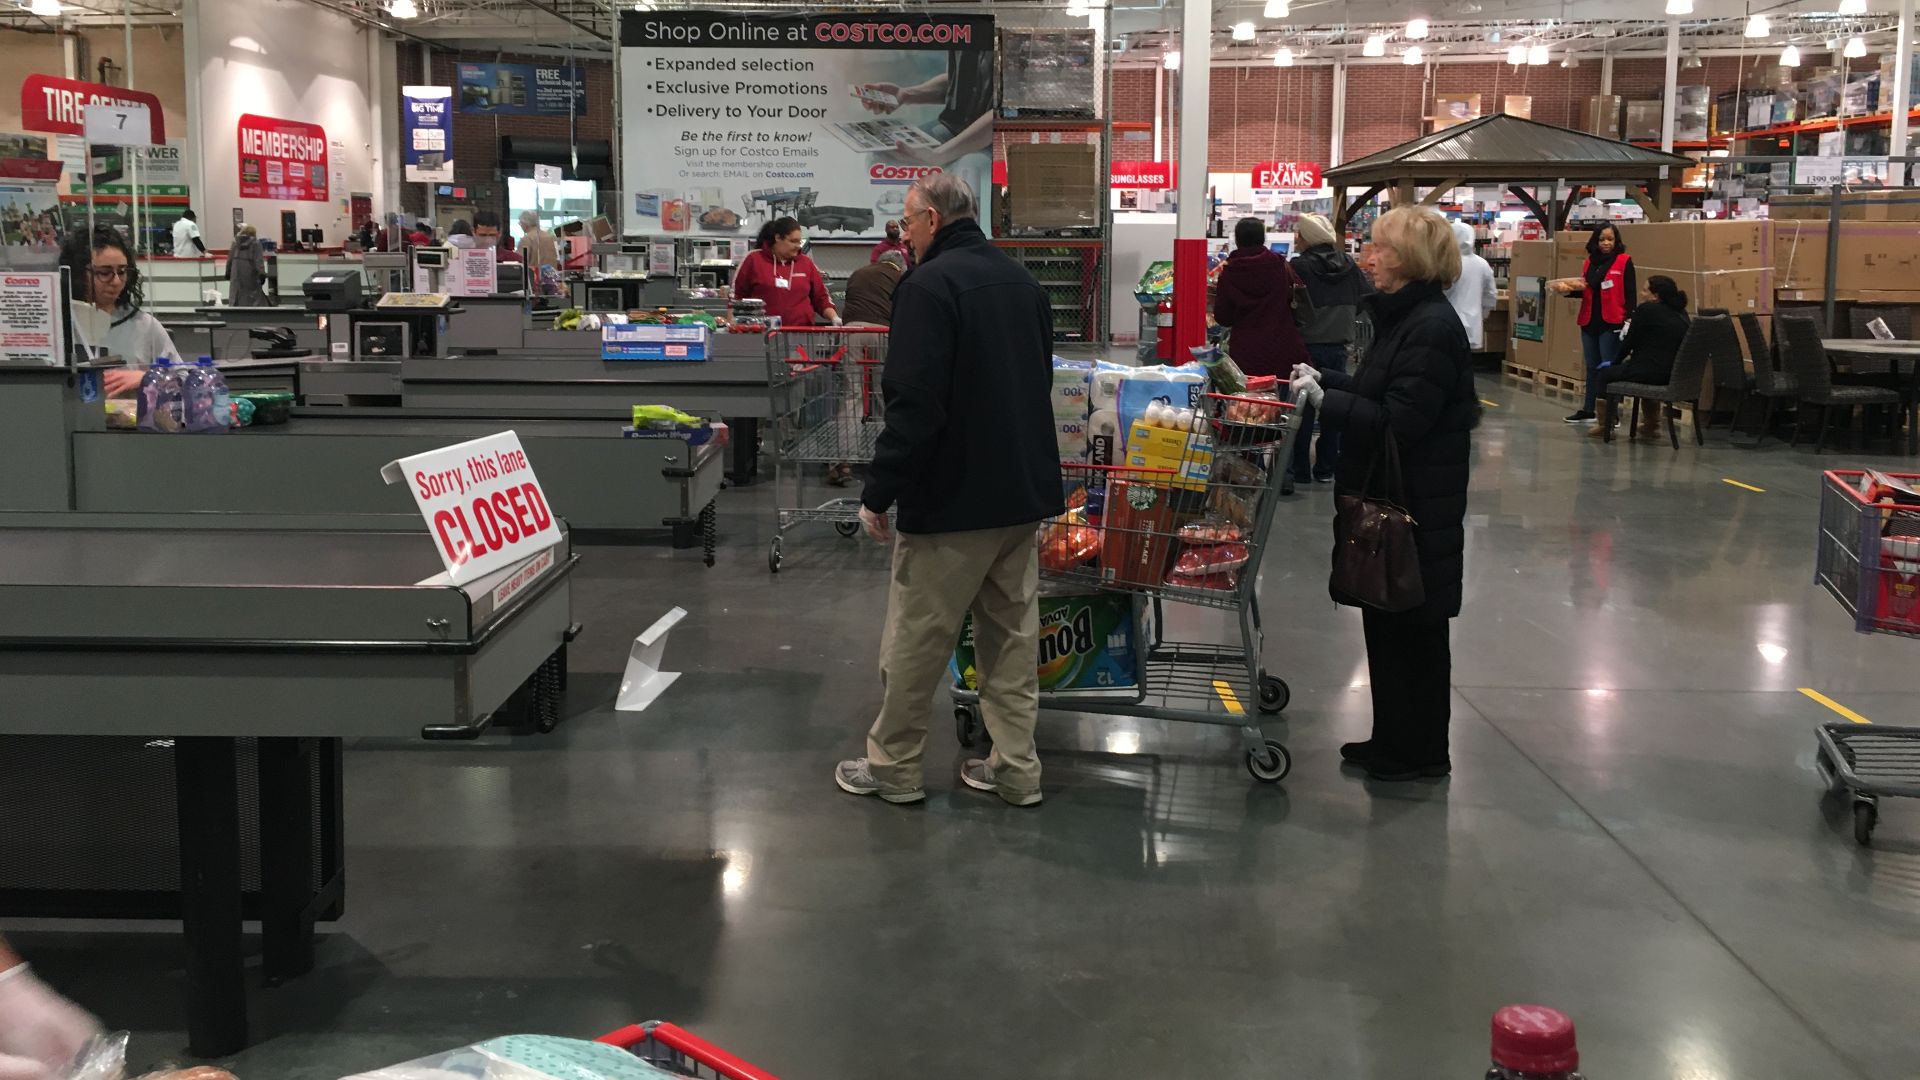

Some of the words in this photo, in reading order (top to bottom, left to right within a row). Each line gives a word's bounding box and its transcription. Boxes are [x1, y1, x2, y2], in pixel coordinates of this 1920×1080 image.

[645, 21, 701, 43] Shop
[708, 22, 779, 41] Online
[787, 24, 808, 41] at
[814, 22, 972, 44] COSTCO.COM
[655, 57, 736, 73] Expanded
[741, 57, 814, 72] selection
[535, 68, 560, 80] FREE
[655, 80, 730, 94] Exclusive
[735, 81, 828, 95] Promotions
[42, 86, 85, 125] TIRE
[655, 103, 721, 119] Delivery
[725, 105, 742, 118] to
[747, 105, 783, 118] Your
[788, 105, 827, 118] Door
[115, 113, 128, 130] 7
[680, 131, 699, 142] Be
[702, 131, 723, 142] the
[726, 131, 753, 142] first
[756, 132, 770, 142] to
[773, 132, 813, 142] know!
[241, 127, 324, 162] MEMBERSHIP
[674, 146, 700, 158] Sign
[702, 148, 718, 158] up
[720, 146, 736, 156] for
[740, 146, 779, 157] Costco
[783, 147, 820, 157] Emails
[686, 160, 704, 168] Visit
[706, 160, 720, 168] the
[722, 161, 774, 169] membership
[1277, 162, 1297, 172] EYE
[679, 170, 691, 178] Or
[1110, 174, 1165, 184] SUNGLASSES
[1260, 170, 1314, 186] EXAMS
[1063, 387, 1082, 397] 100
[1062, 424, 1082, 434] 100
[415, 467, 472, 500] Sorry,
[466, 455, 498, 484] this
[494, 449, 527, 476] lane
[433, 482, 552, 566] CLOSED
[1096, 671, 1116, 686] 12
